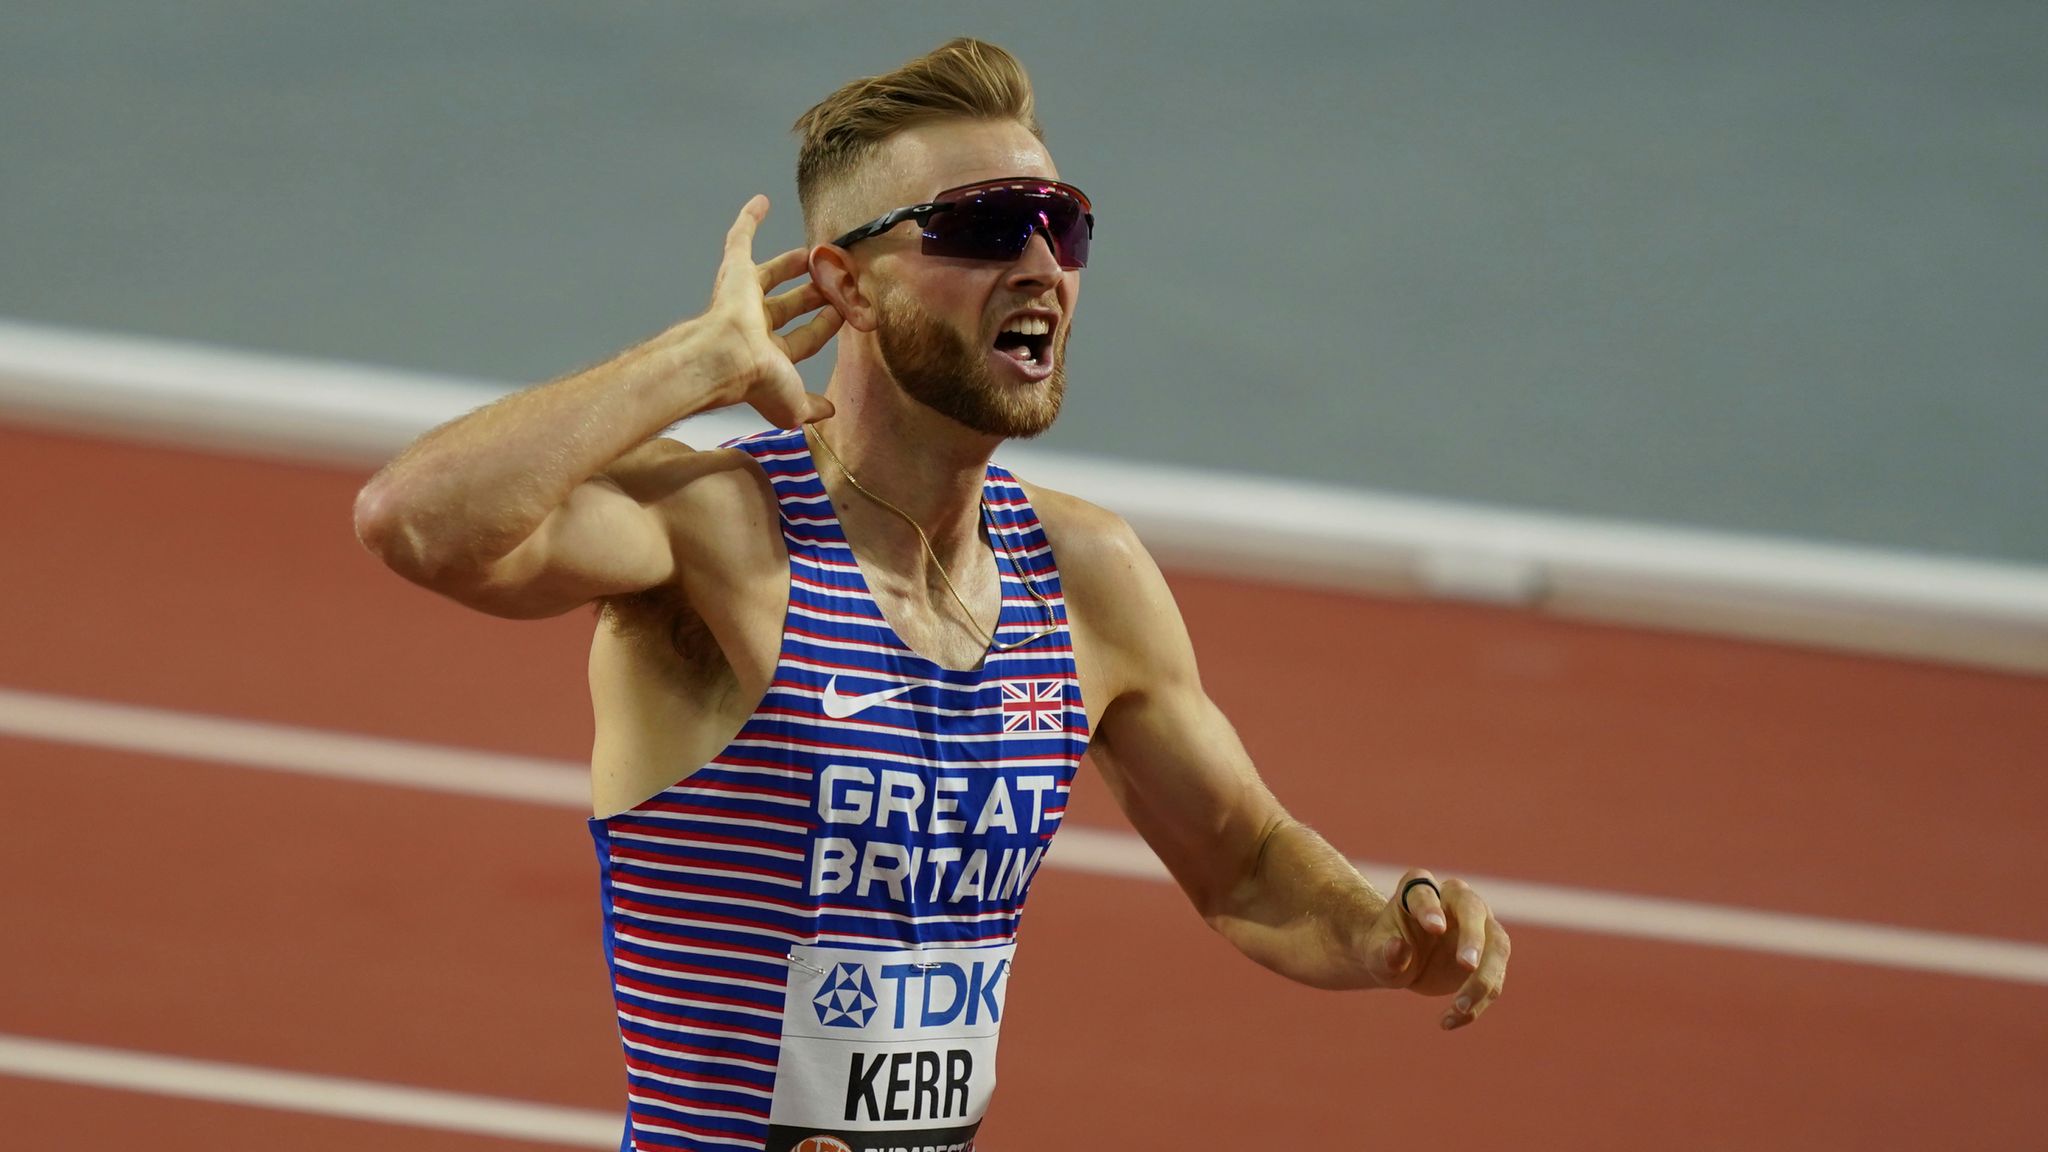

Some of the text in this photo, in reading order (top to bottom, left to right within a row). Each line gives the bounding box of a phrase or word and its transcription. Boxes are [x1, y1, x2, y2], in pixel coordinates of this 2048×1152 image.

[817, 764, 1054, 834] GREAT
[809, 837, 1044, 903] BRITAIN
[880, 959, 1006, 1029] TDK
[844, 1049, 973, 1121] KERR
